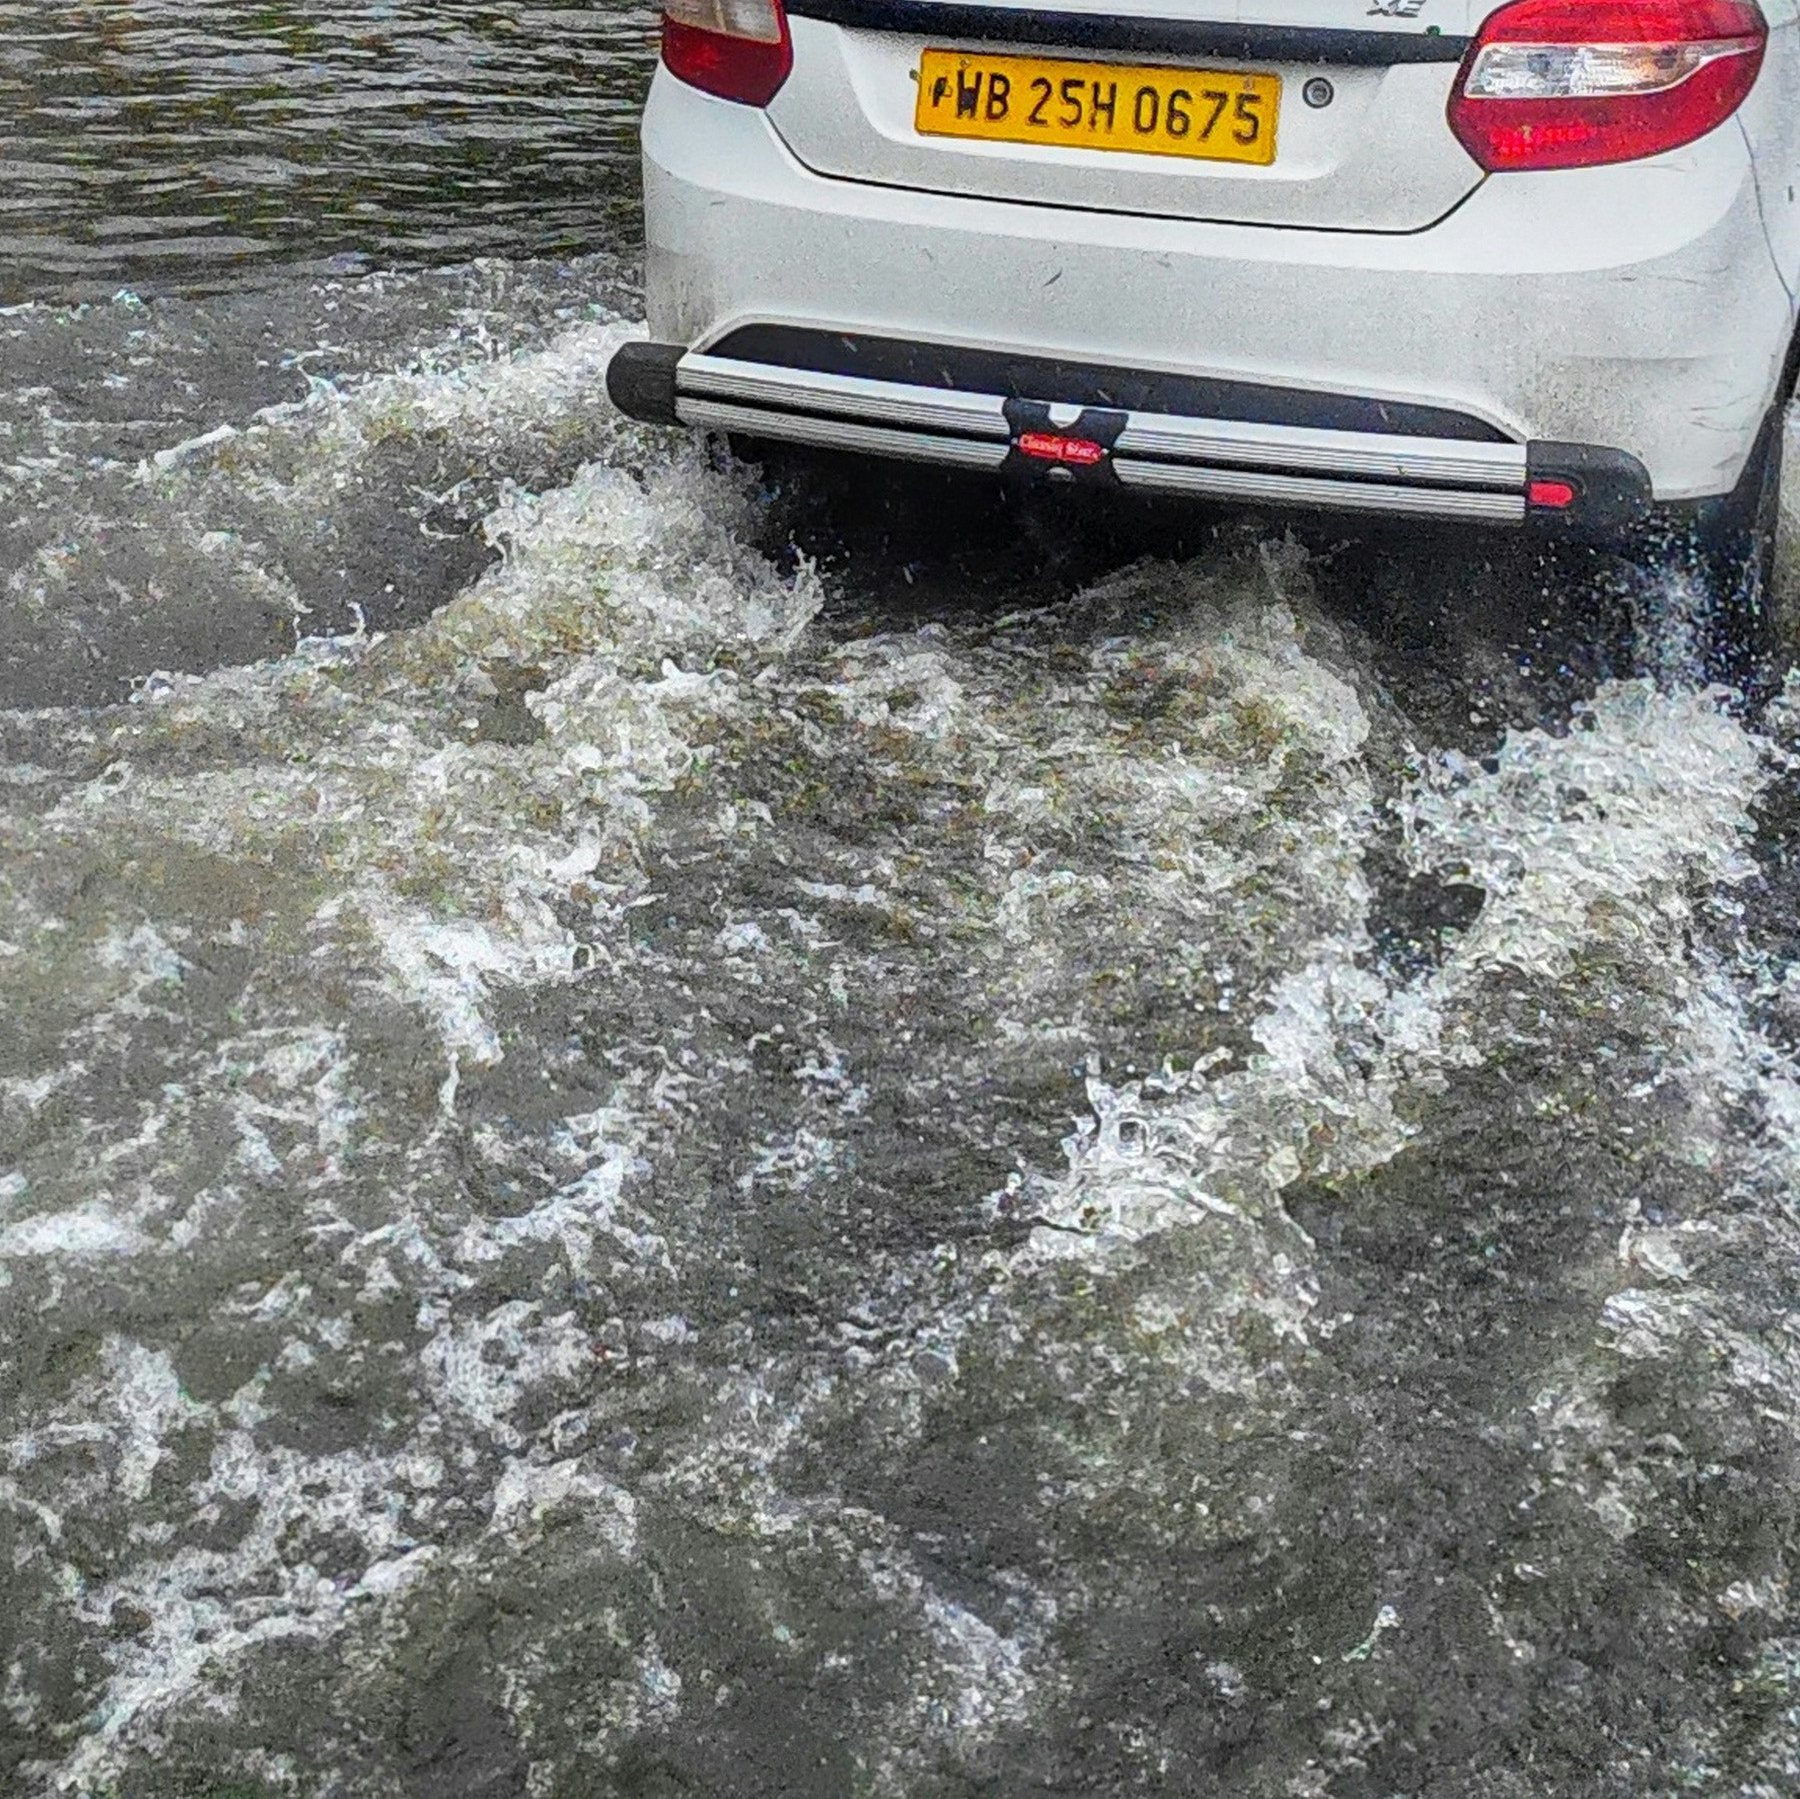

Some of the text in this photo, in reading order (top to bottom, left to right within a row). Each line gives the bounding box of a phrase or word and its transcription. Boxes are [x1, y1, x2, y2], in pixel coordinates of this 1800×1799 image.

[956, 67, 1263, 146] WB 25H 0675
